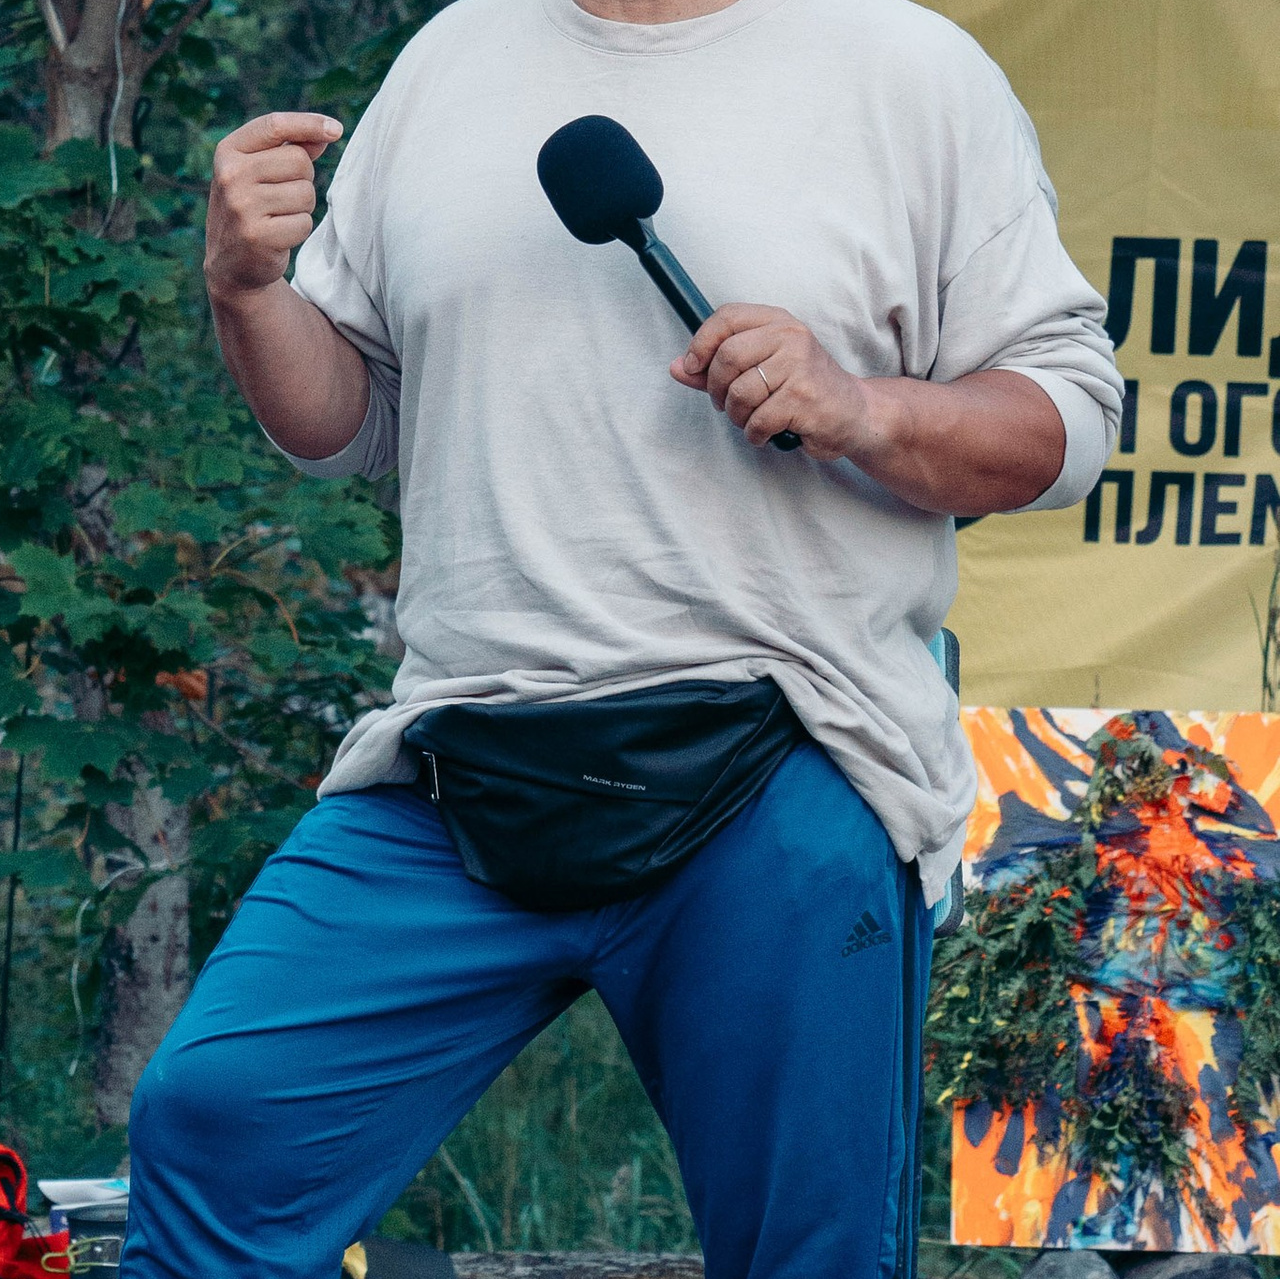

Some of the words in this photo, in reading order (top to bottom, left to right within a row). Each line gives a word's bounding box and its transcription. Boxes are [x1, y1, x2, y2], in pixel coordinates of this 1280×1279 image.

[1105, 236, 1280, 379] ЛИ
[1170, 380, 1280, 457] ОГ
[583, 774, 612, 786] MARK
[613, 781, 646, 791] RYDEN
[841, 931, 892, 958] adidas
